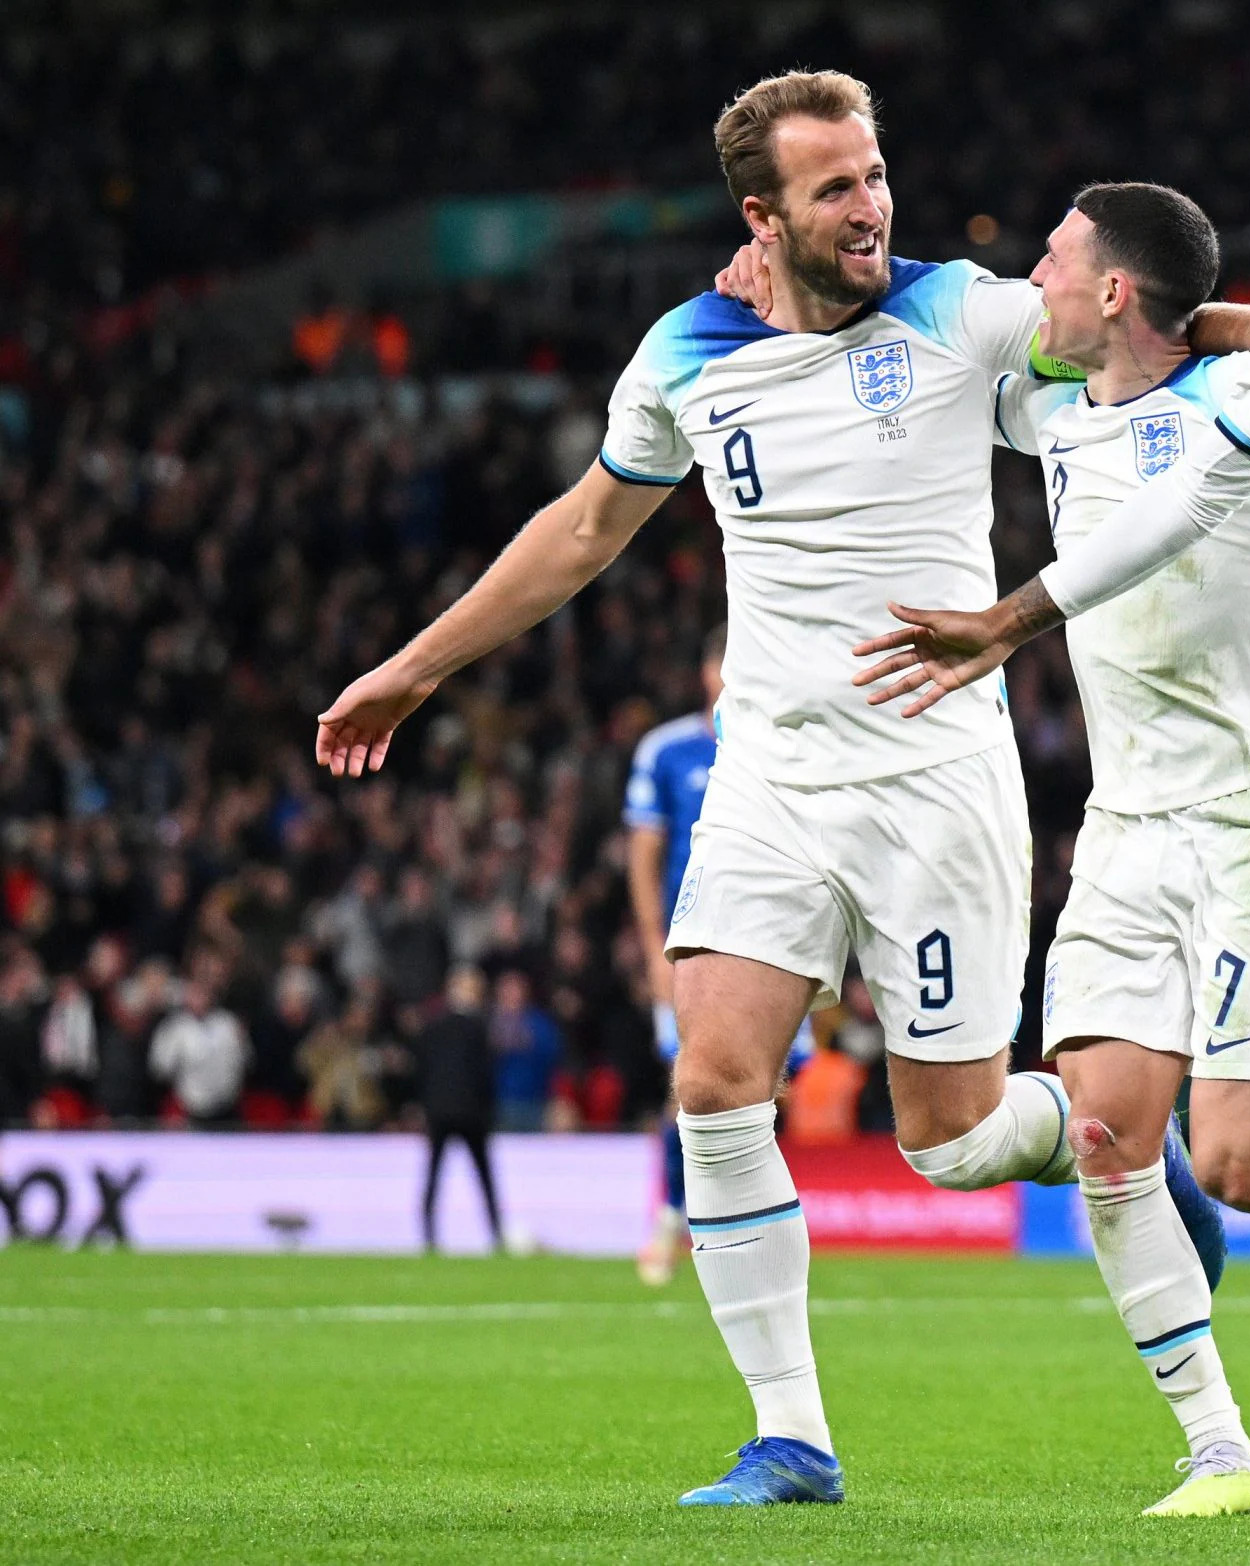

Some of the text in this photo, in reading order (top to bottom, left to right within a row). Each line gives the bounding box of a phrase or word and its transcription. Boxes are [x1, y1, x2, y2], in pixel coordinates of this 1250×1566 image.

[723, 427, 763, 508] 9
[916, 928, 954, 1010] 9
[1214, 949, 1247, 1027] 7
[0, 1163, 145, 1246] OX
